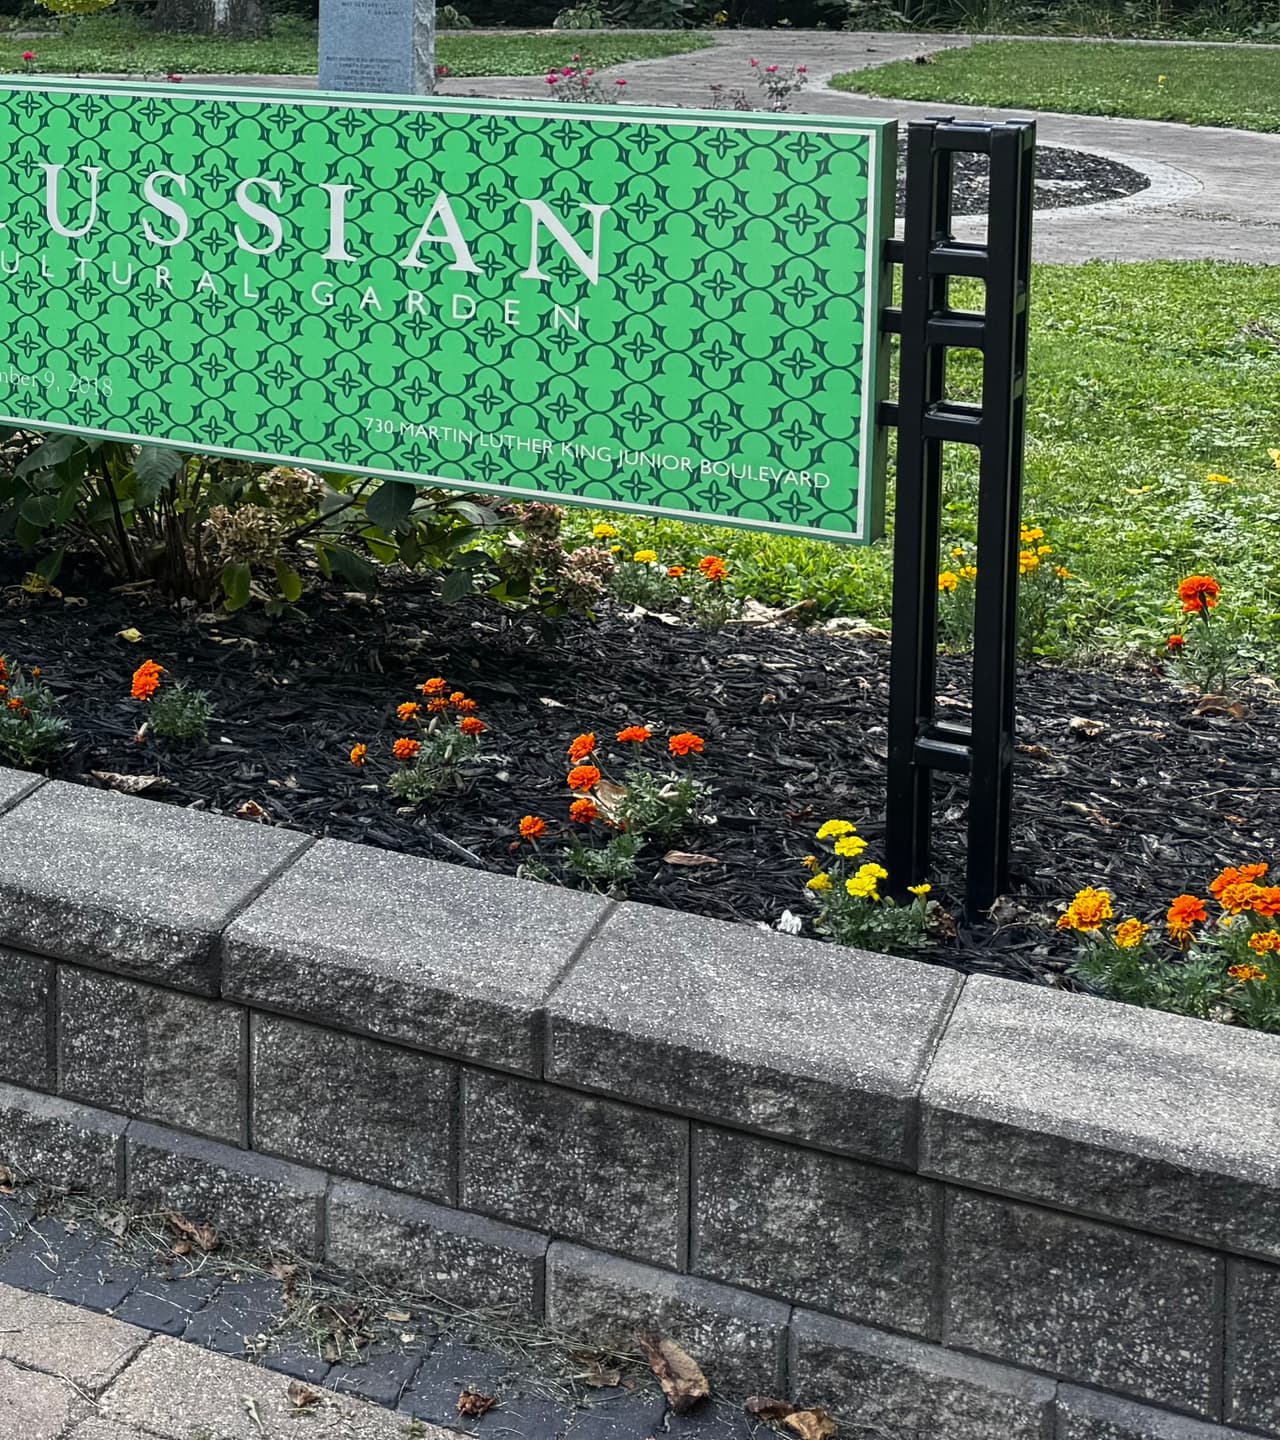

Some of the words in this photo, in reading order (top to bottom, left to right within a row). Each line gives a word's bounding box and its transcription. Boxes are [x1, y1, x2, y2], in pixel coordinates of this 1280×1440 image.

[311, 281, 580, 331] GARDEN
[45, 370, 60, 393] 9,
[69, 374, 113, 398] 2018
[364, 417, 393, 435] 730
[400, 422, 473, 446] MARTIN
[479, 430, 553, 455] LUTHER
[561, 441, 611, 463] KING
[617, 449, 693, 474] JUNIOR
[700, 460, 830, 489] BOULEVARD
